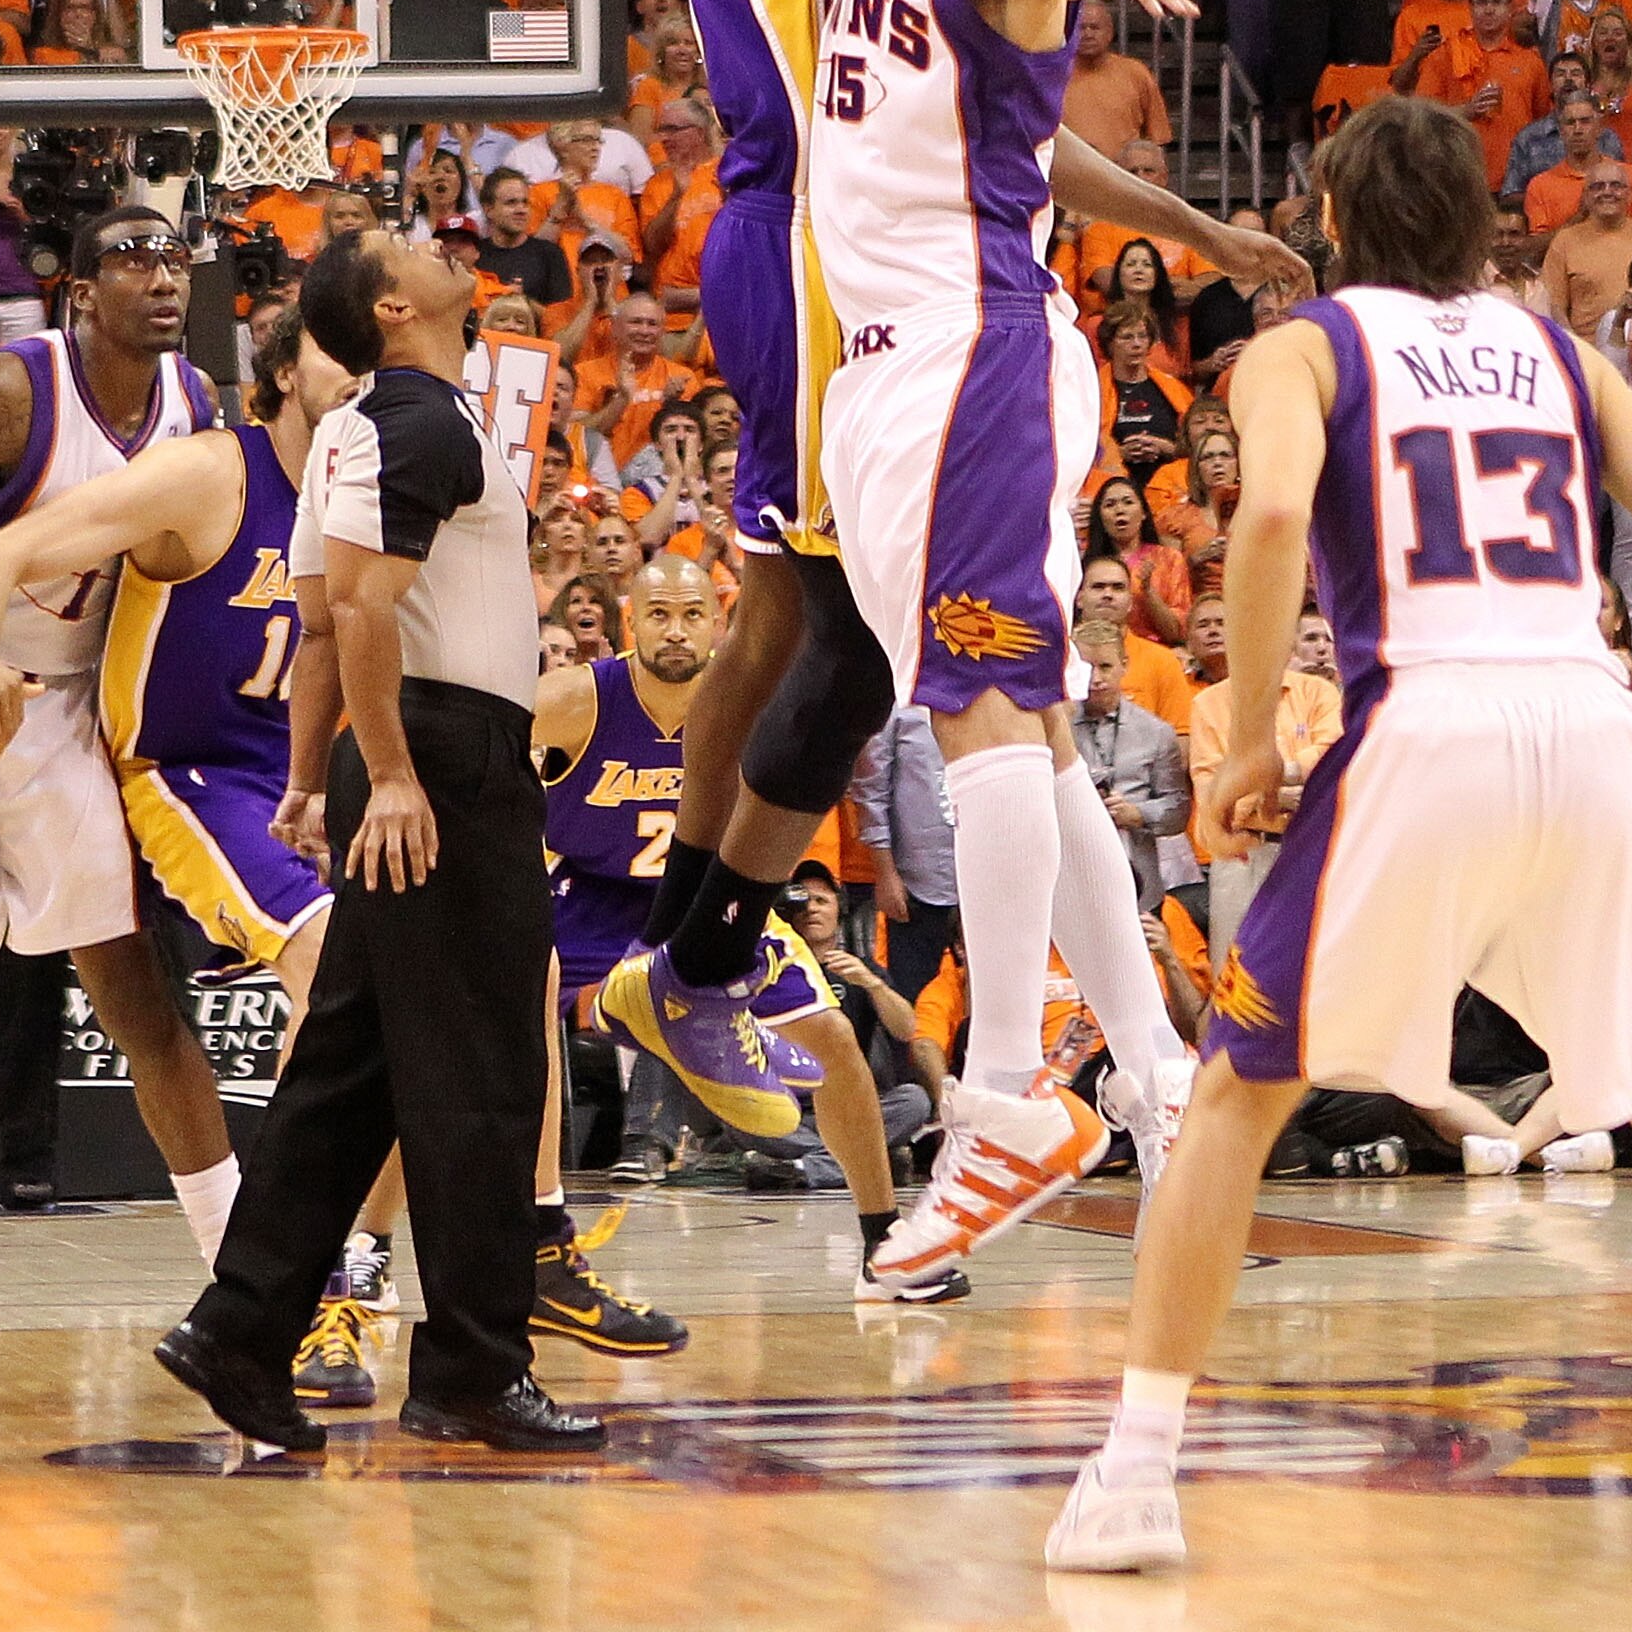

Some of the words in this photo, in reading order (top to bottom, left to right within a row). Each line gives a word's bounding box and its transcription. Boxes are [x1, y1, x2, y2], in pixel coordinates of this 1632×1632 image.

[1394, 345, 1538, 407] NASH
[1390, 425, 1584, 590] 13
[238, 614, 296, 701] 1
